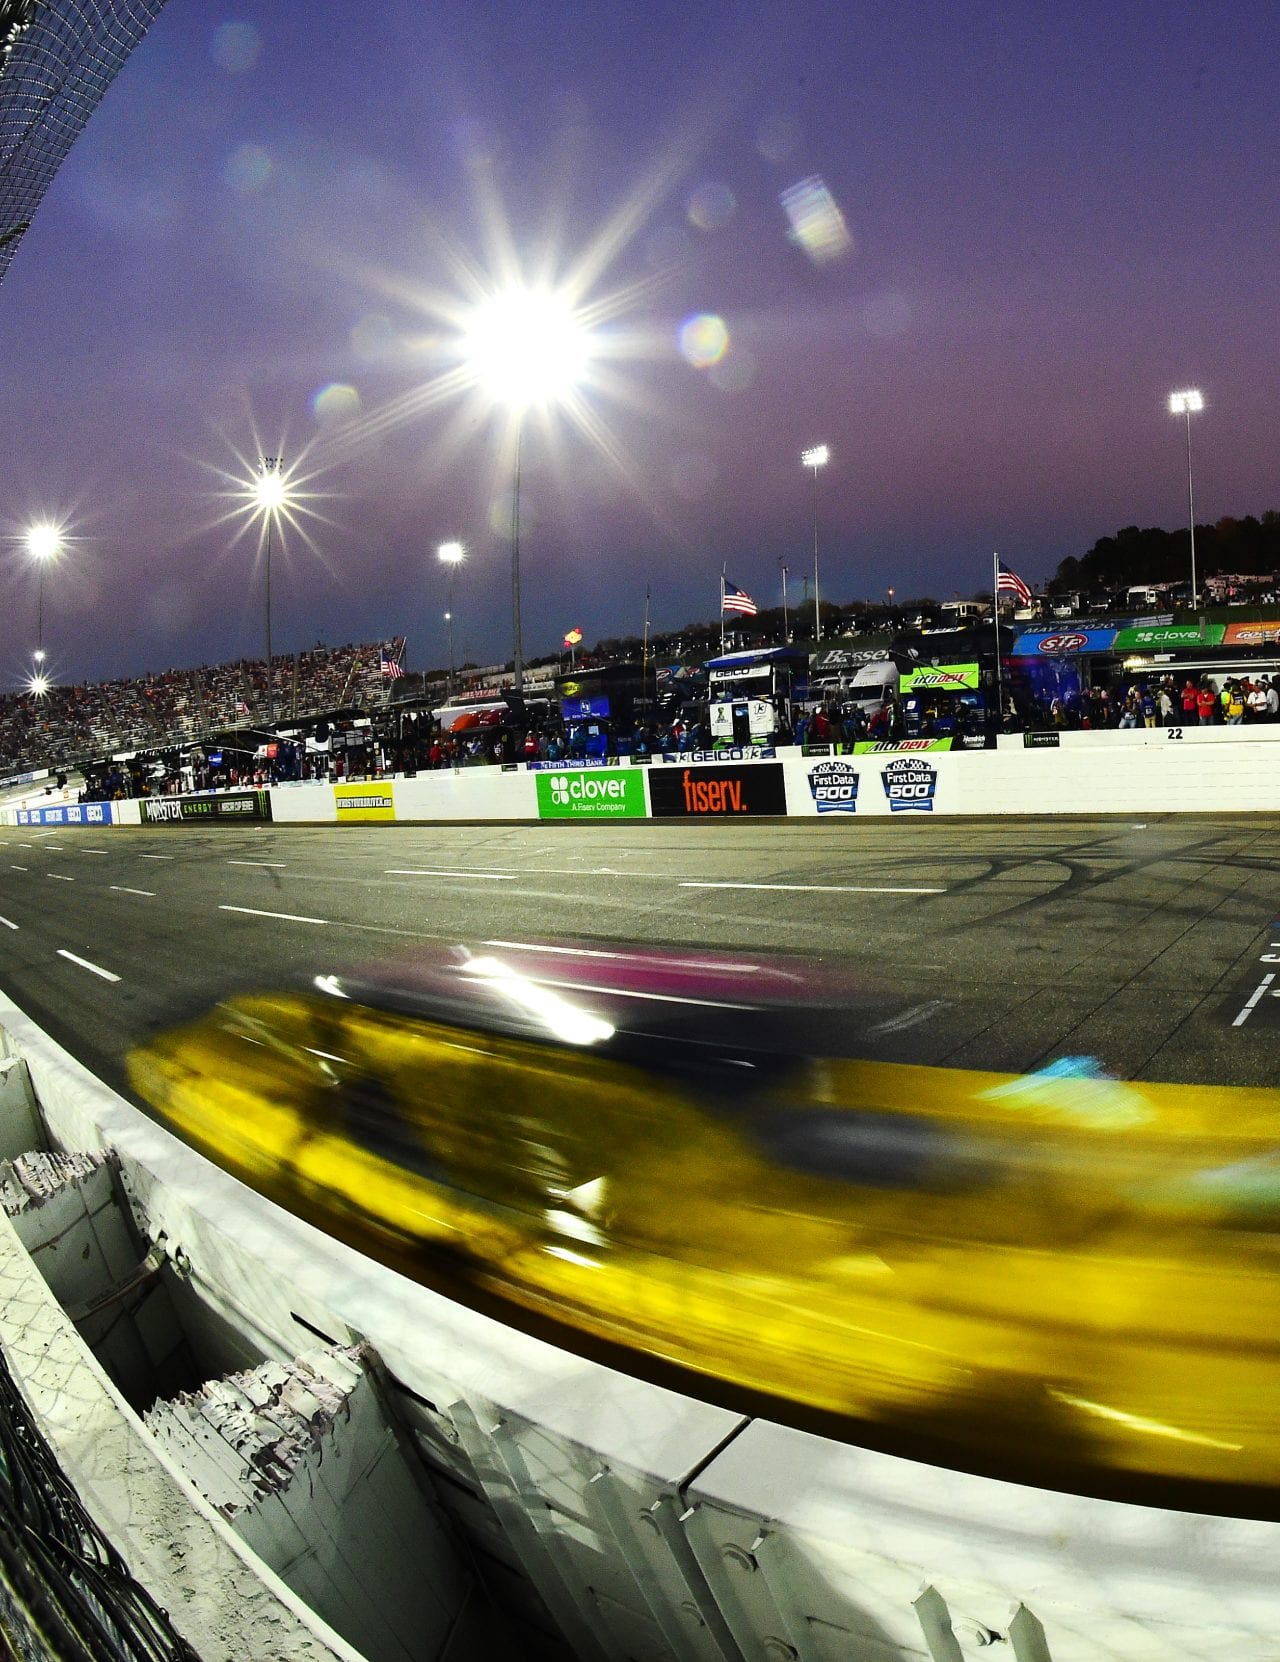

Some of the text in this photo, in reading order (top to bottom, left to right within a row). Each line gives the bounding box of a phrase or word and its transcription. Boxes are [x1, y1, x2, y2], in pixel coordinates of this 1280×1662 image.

[1044, 635, 1082, 650] STP
[716, 668, 750, 677] GEICO
[1167, 728, 1183, 740] 22
[692, 750, 743, 762] GEICO
[566, 760, 586, 768] THIRD
[586, 759, 603, 767] BANK
[814, 774, 854, 785] First Data
[888, 772, 931, 783] First Data
[570, 774, 626, 799] clover
[683, 769, 747, 812] fiserv.
[889, 785, 929, 797] 500
[815, 787, 852, 799] 500
[145, 799, 183, 824] MONSTER
[184, 803, 213, 813] ENERGY
[578, 803, 595, 811] Fiserv
[596, 802, 626, 812] Company
